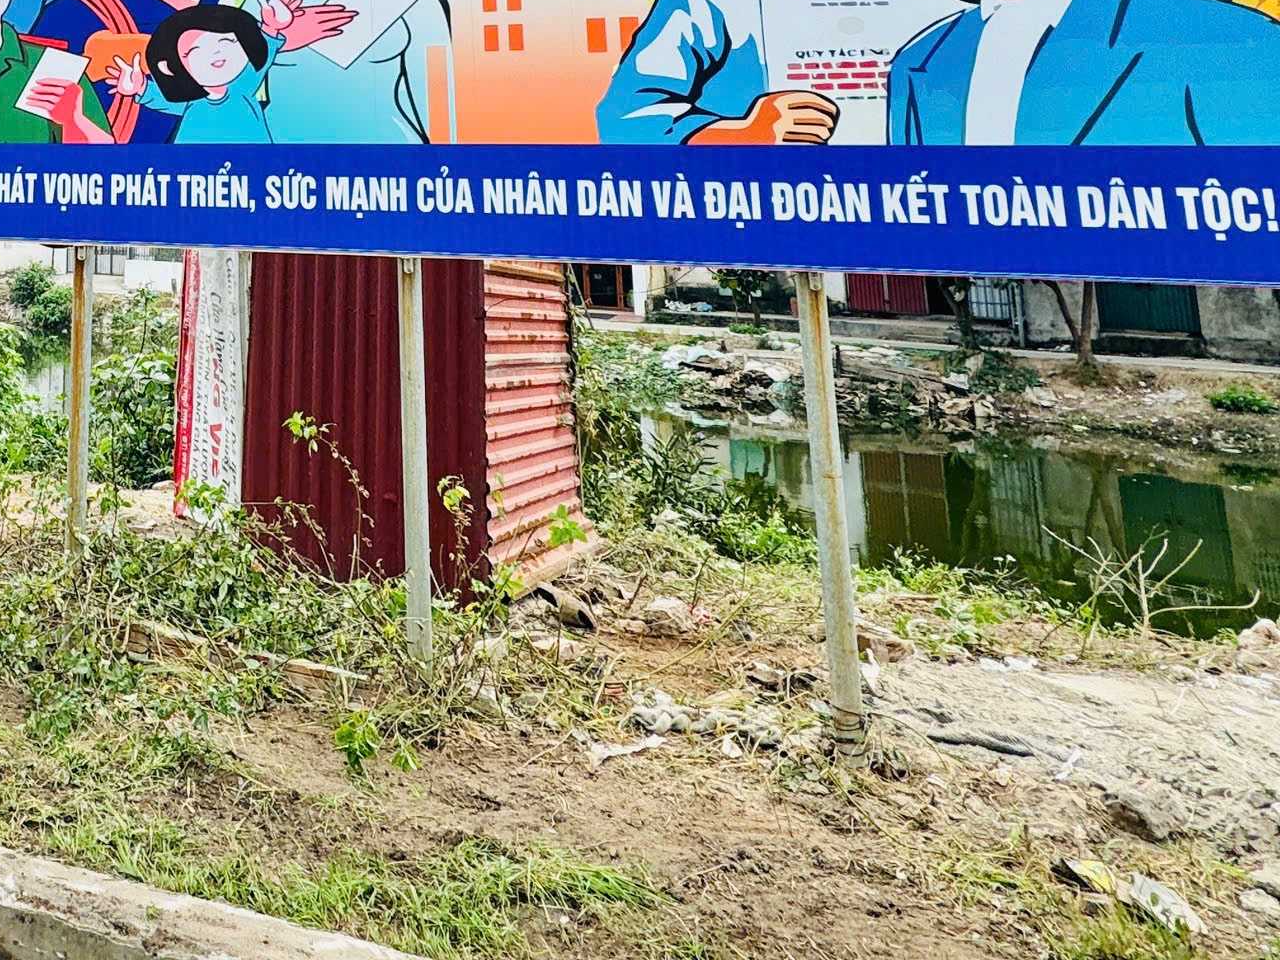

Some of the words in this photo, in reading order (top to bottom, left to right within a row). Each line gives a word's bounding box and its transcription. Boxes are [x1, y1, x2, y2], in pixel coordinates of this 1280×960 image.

[43, 172, 103, 212] VỌNG
[110, 167, 170, 207] PHÁT
[176, 161, 256, 213] TRIỂN,
[265, 168, 317, 210] SỨC
[325, 176, 408, 219] MẠNH
[416, 165, 475, 214] CỦA
[482, 171, 568, 216] NHÂN
[576, 172, 643, 218] DÂN
[651, 173, 696, 219] VÀ
[703, 181, 762, 229] ĐẠI
[771, 174, 872, 223] ĐOÀN
[881, 170, 949, 225] KẾT
[959, 176, 1067, 227] TOÀN
[1077, 177, 1167, 230] DÂN
[1175, 178, 1279, 241] TỘC!
